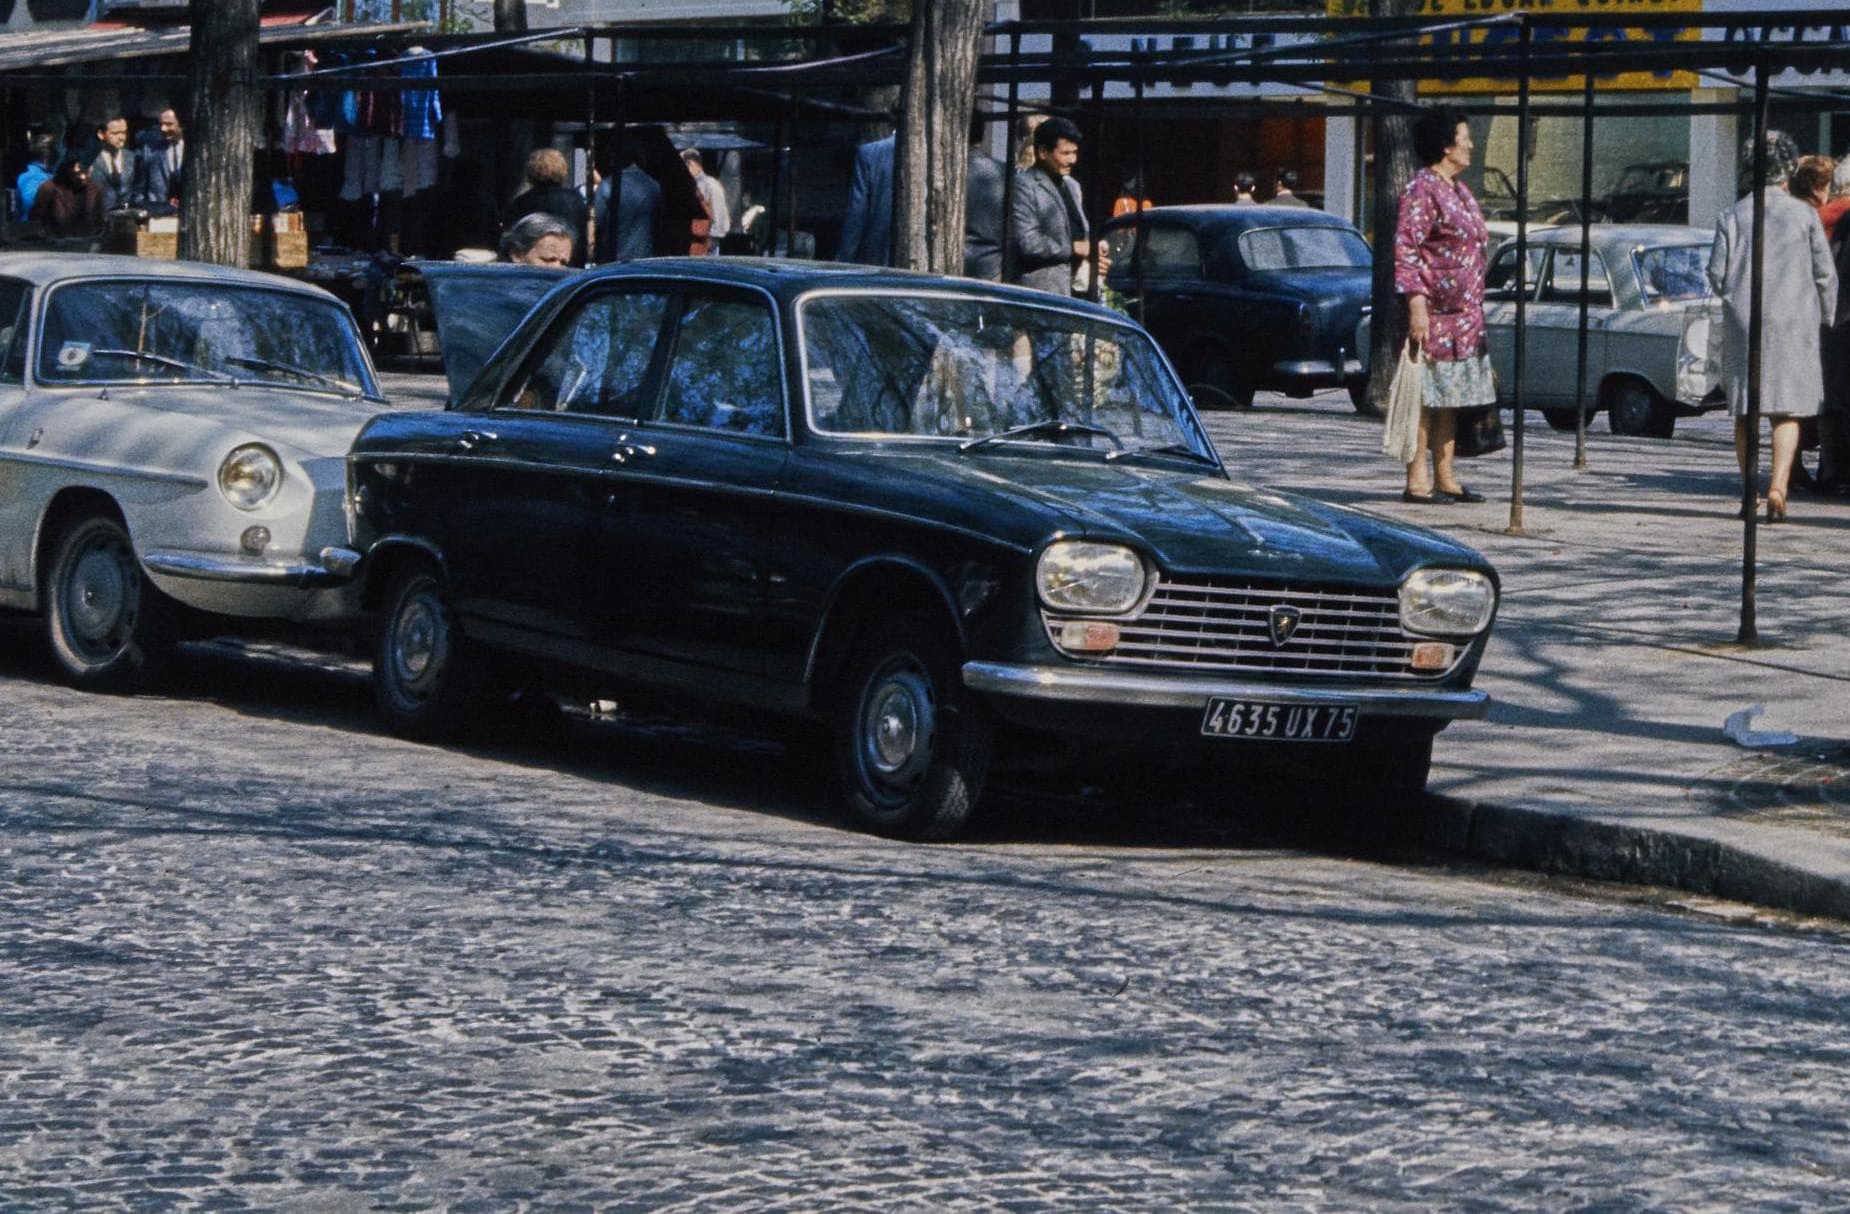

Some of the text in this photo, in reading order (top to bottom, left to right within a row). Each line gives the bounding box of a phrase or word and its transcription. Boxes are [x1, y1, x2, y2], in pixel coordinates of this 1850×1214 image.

[1208, 701, 1354, 739] 4635 UX 75
